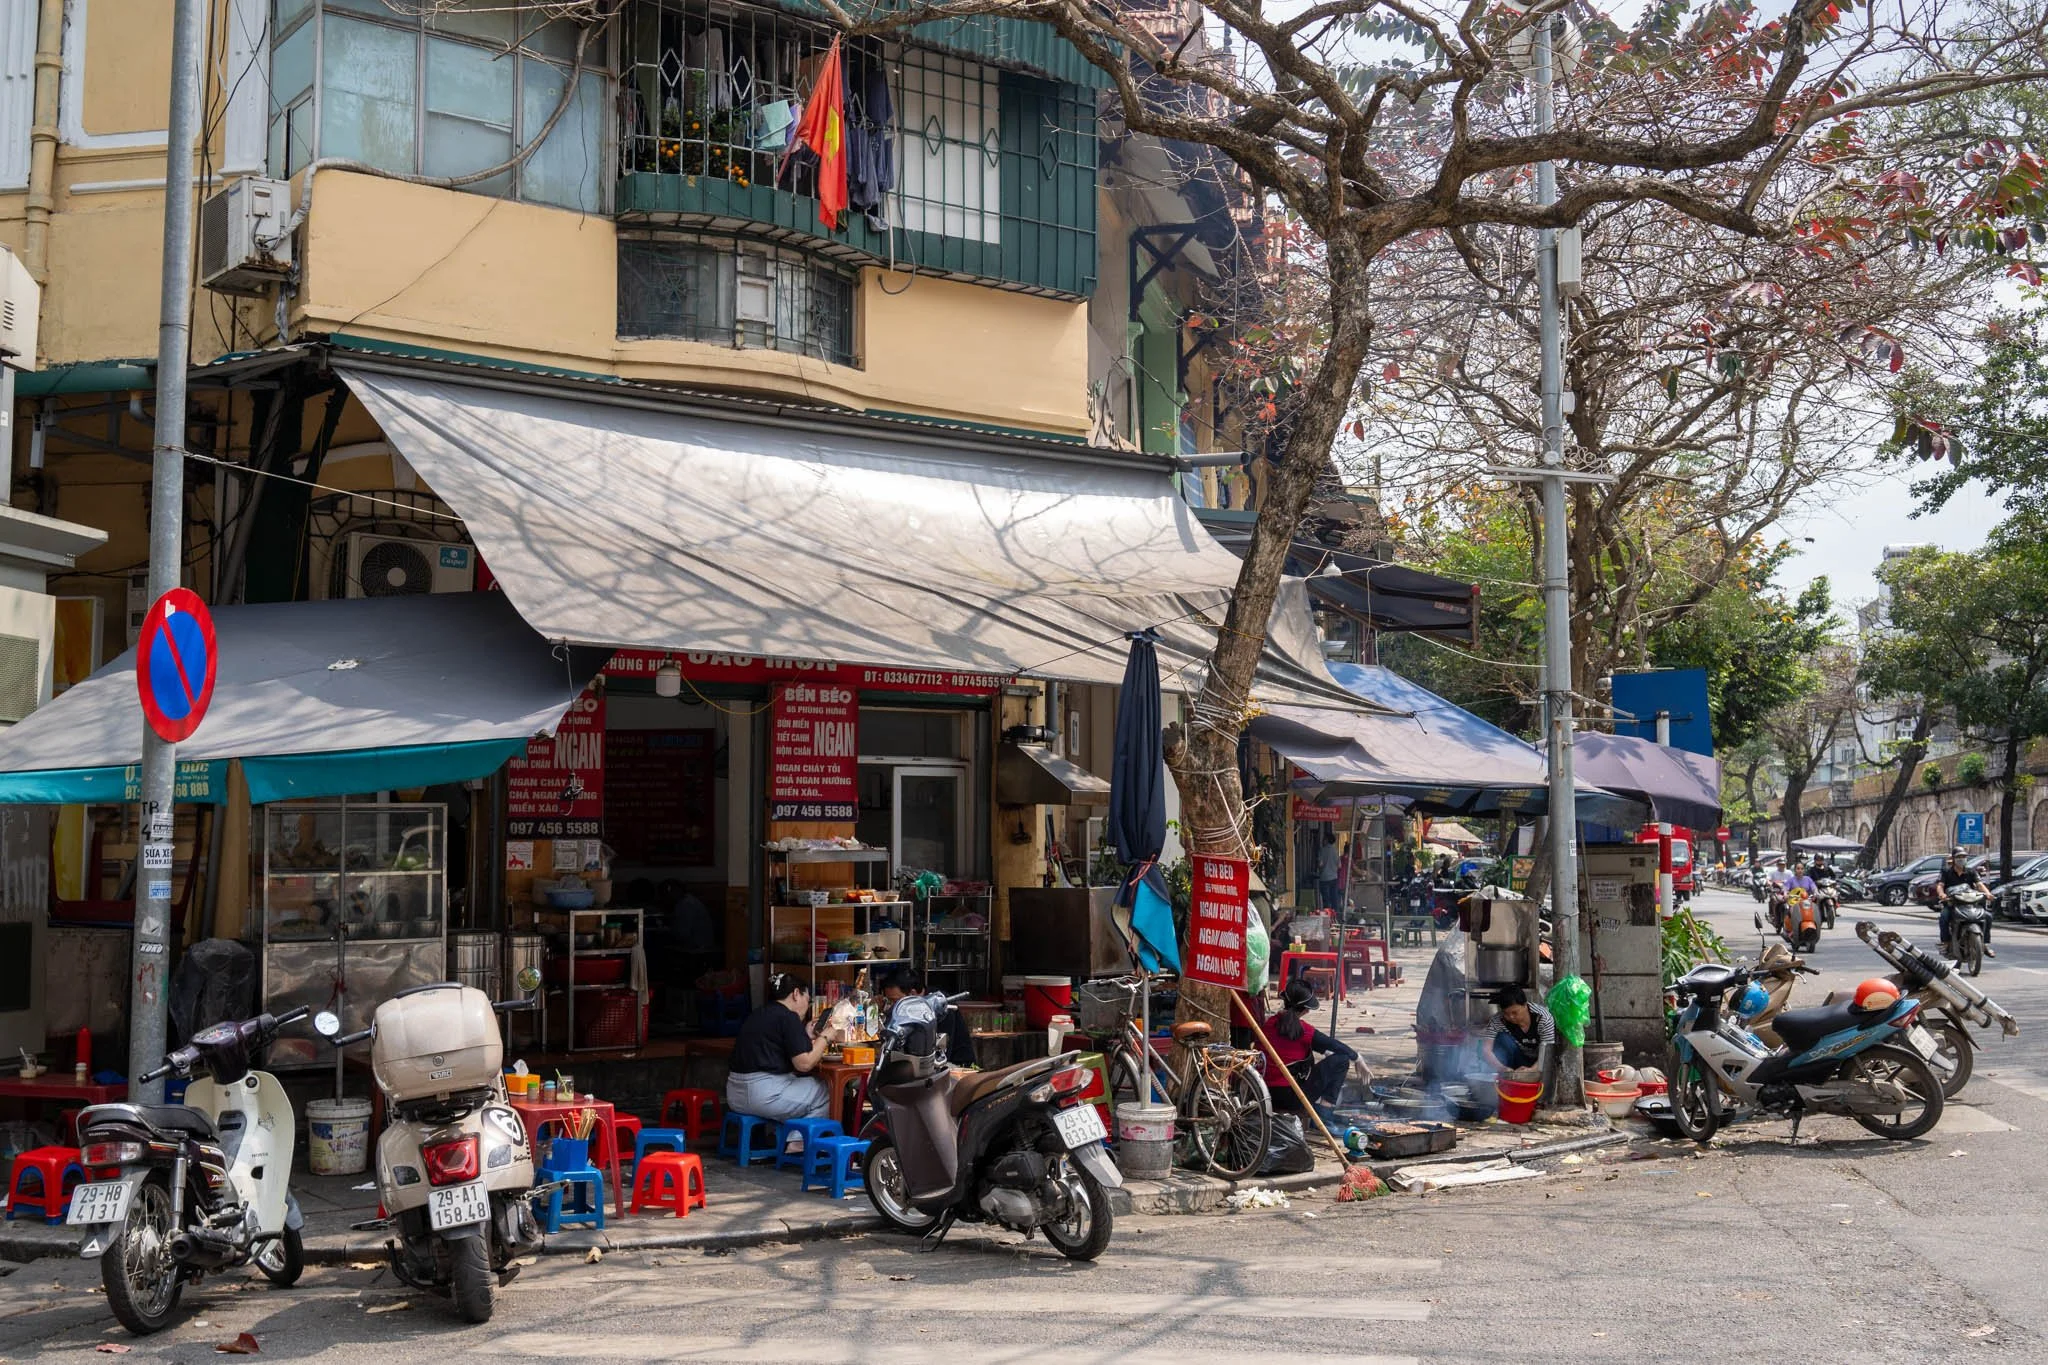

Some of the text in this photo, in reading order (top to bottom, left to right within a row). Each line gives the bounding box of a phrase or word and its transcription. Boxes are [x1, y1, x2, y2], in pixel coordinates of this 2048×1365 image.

[602, 654, 643, 671] HÙNG
[884, 671, 943, 685] 0334677112
[814, 721, 855, 757] NGAN
[554, 732, 602, 770] NGAN
[776, 764, 801, 772] NGAN
[796, 776, 820, 785] NGAN
[776, 804, 853, 817] 097 456 5588
[510, 822, 599, 835] 097 456 5588
[1965, 818, 1976, 831] P
[1200, 900, 1219, 919] NGAN
[1199, 928, 1220, 946] NGAN
[1196, 953, 1220, 974] NGAN
[80, 1185, 123, 1203] 29-H8
[437, 1185, 478, 1208] 29-A1
[76, 1202, 118, 1222] 4131
[435, 1202, 487, 1227] 158.48
